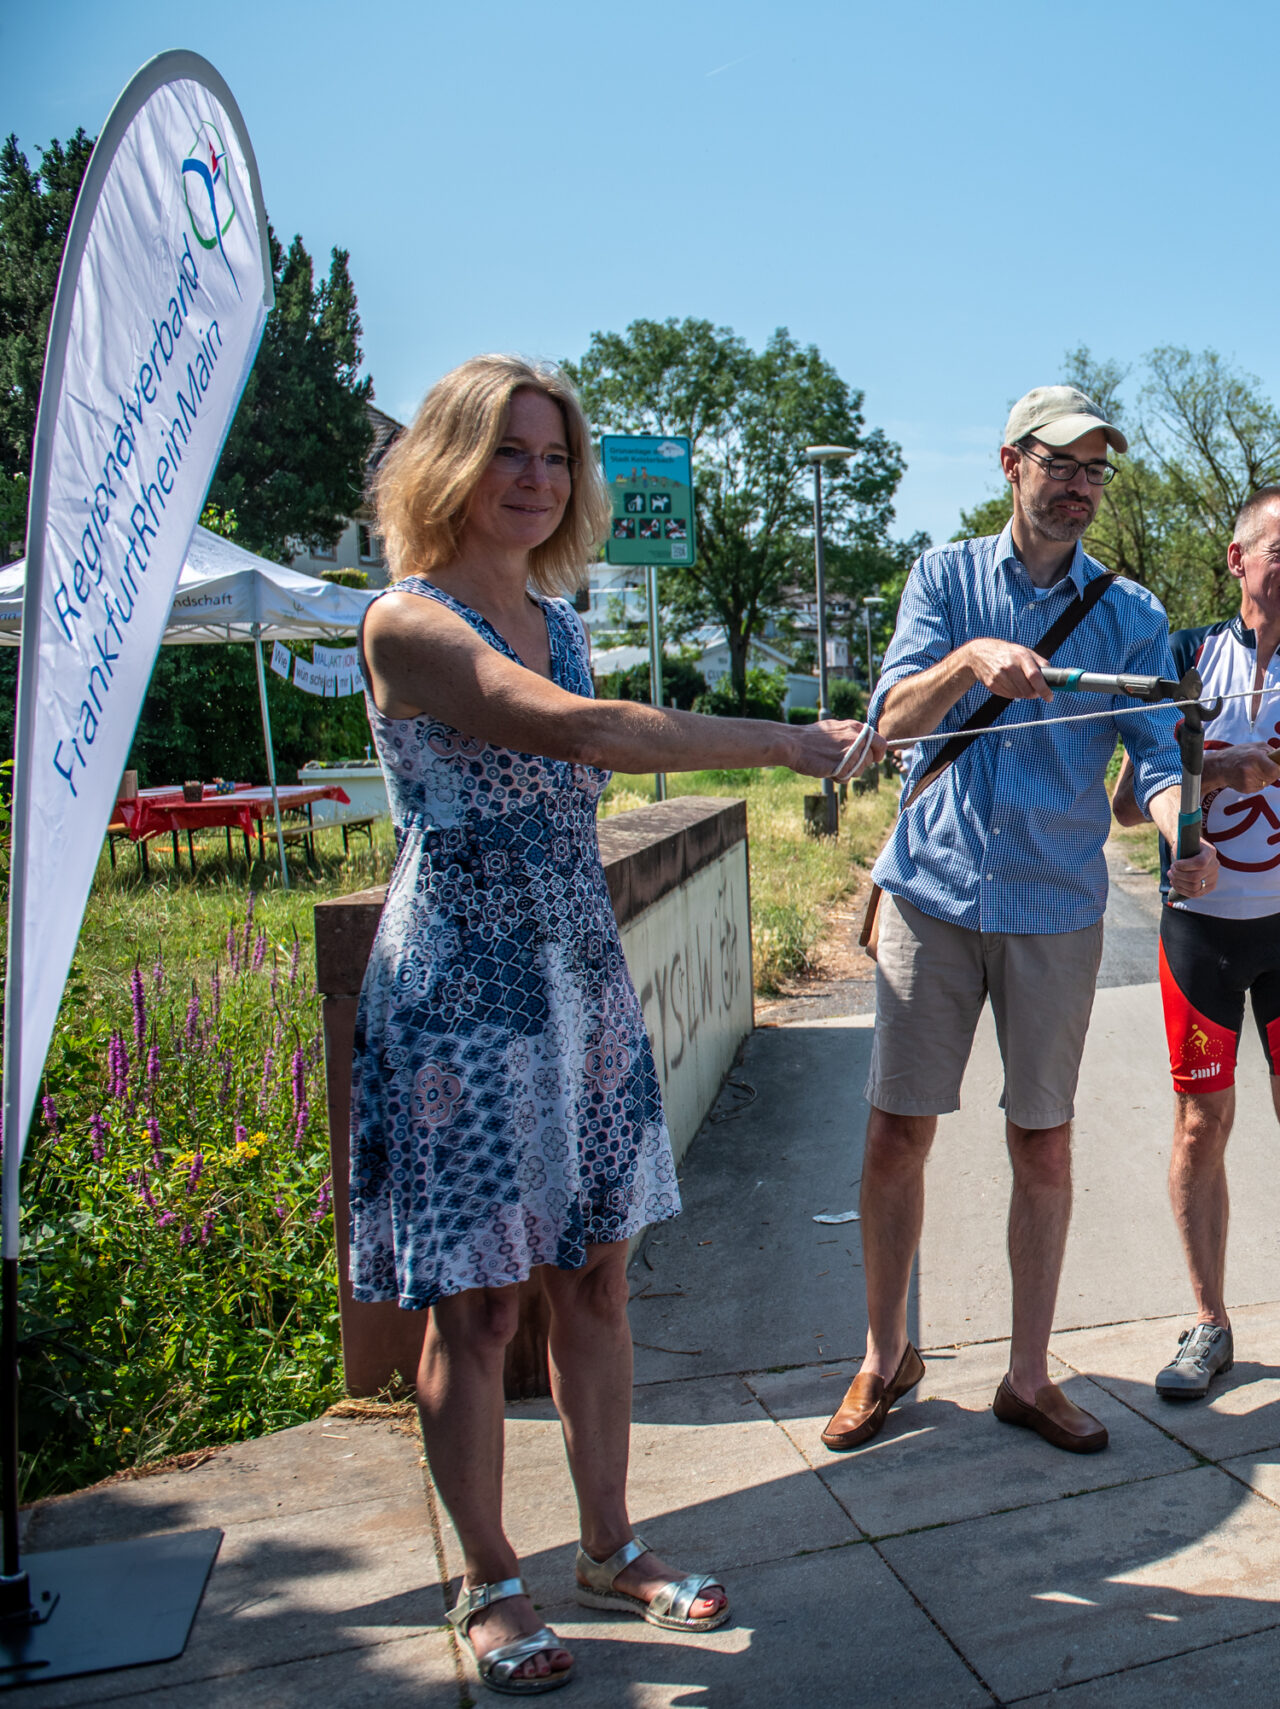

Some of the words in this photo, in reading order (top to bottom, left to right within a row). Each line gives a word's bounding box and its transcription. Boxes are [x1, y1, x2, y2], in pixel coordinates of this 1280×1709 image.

[53, 319, 222, 797] FrankfurtRheinMain
[54, 231, 199, 642] Regionalverband
[275, 648, 287, 669] Wie
